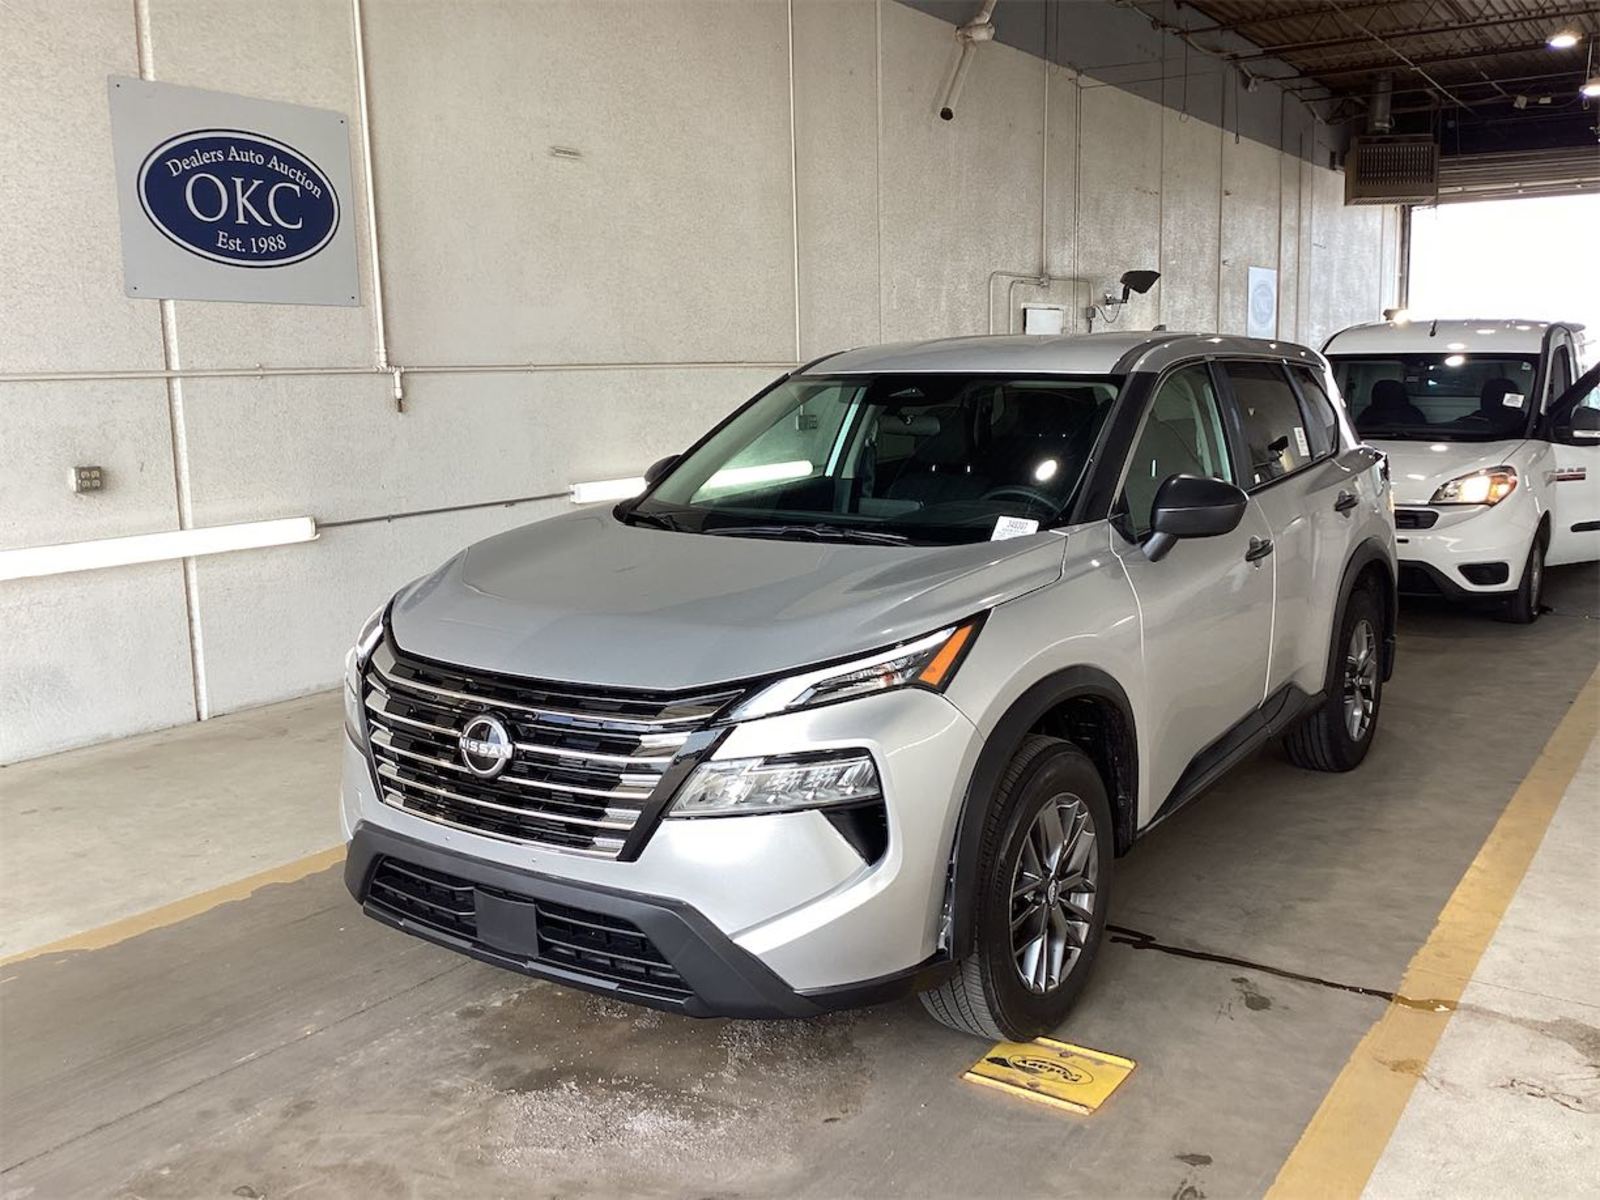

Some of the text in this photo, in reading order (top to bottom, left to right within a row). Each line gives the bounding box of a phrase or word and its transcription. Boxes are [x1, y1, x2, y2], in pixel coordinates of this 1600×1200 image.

[165, 145, 323, 199] Dealers Auto Auction
[185, 172, 303, 230] OKC
[216, 230, 287, 254] Est. 1988
[460, 738, 509, 756] NISSAN
